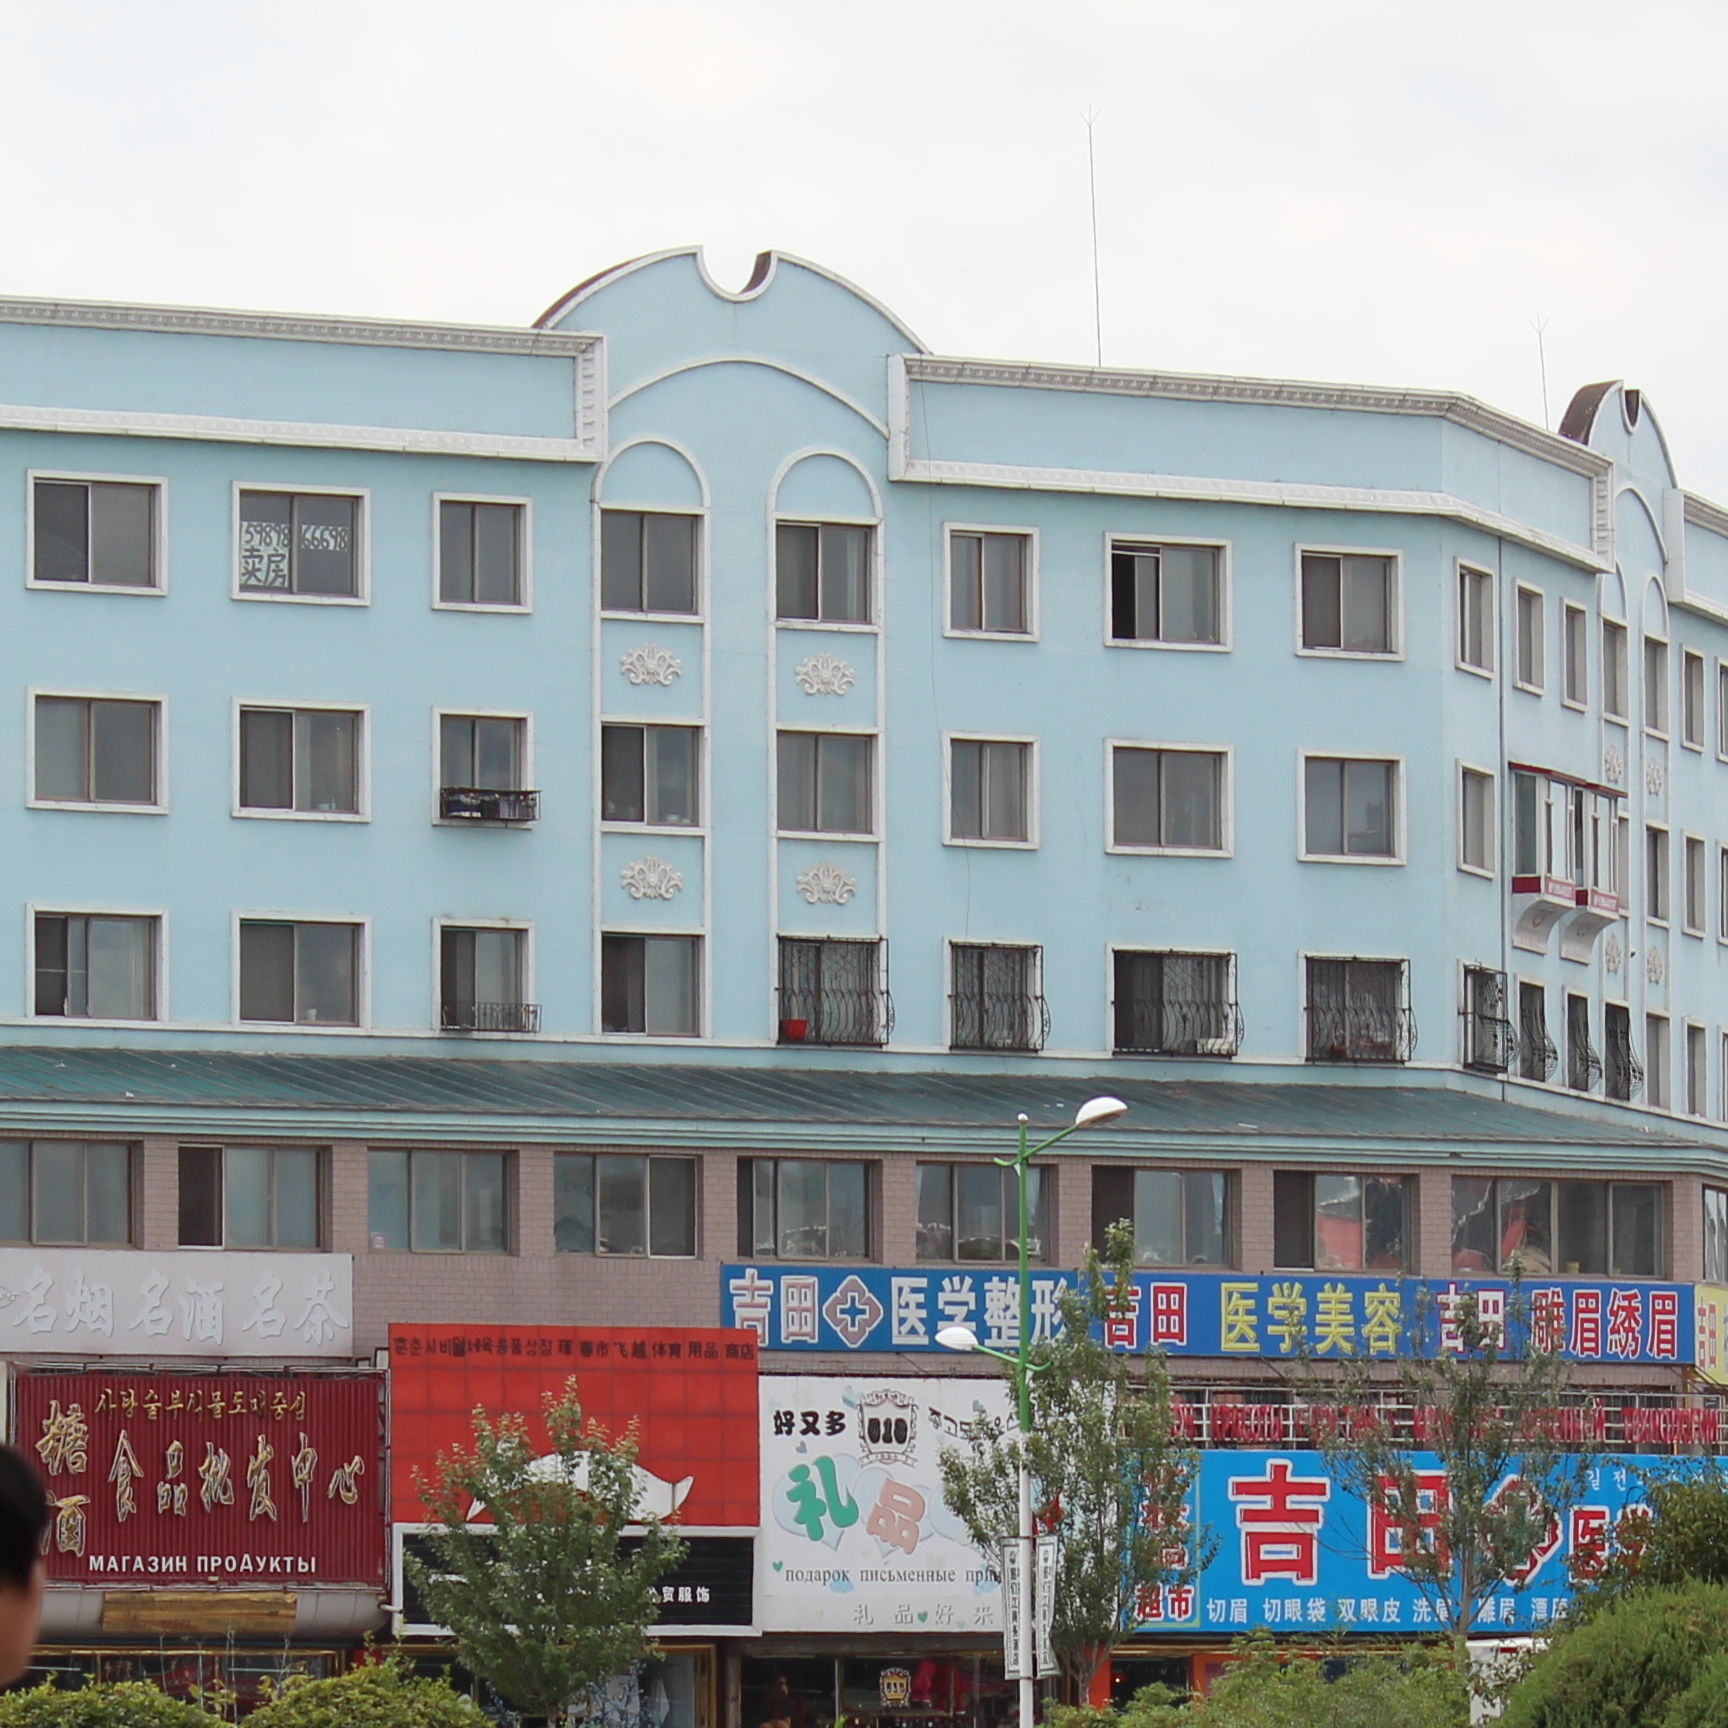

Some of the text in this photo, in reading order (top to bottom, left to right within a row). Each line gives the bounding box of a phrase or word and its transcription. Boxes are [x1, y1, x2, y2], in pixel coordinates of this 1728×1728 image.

[242, 546, 287, 586] 卖房
[13, 1264, 350, 1345] 名烟名酒名茶
[729, 1267, 819, 1347] 吉田
[890, 1274, 1064, 1348] 医学整形
[1103, 1282, 1187, 1349] 吉田
[1219, 1281, 1403, 1356] 医学美容
[773, 1410, 847, 1437] 好又多
[1227, 1458, 1454, 1588] 吉田
[89, 1553, 317, 1573] МАГАЗИН ПРОДУКТЫ
[784, 1566, 850, 1588] подарок
[859, 1566, 957, 1583] письменные
[1206, 1597, 1249, 1624] 切眉
[1262, 1597, 1326, 1624] 切眼袋
[1337, 1598, 1401, 1625] 双眼皮
